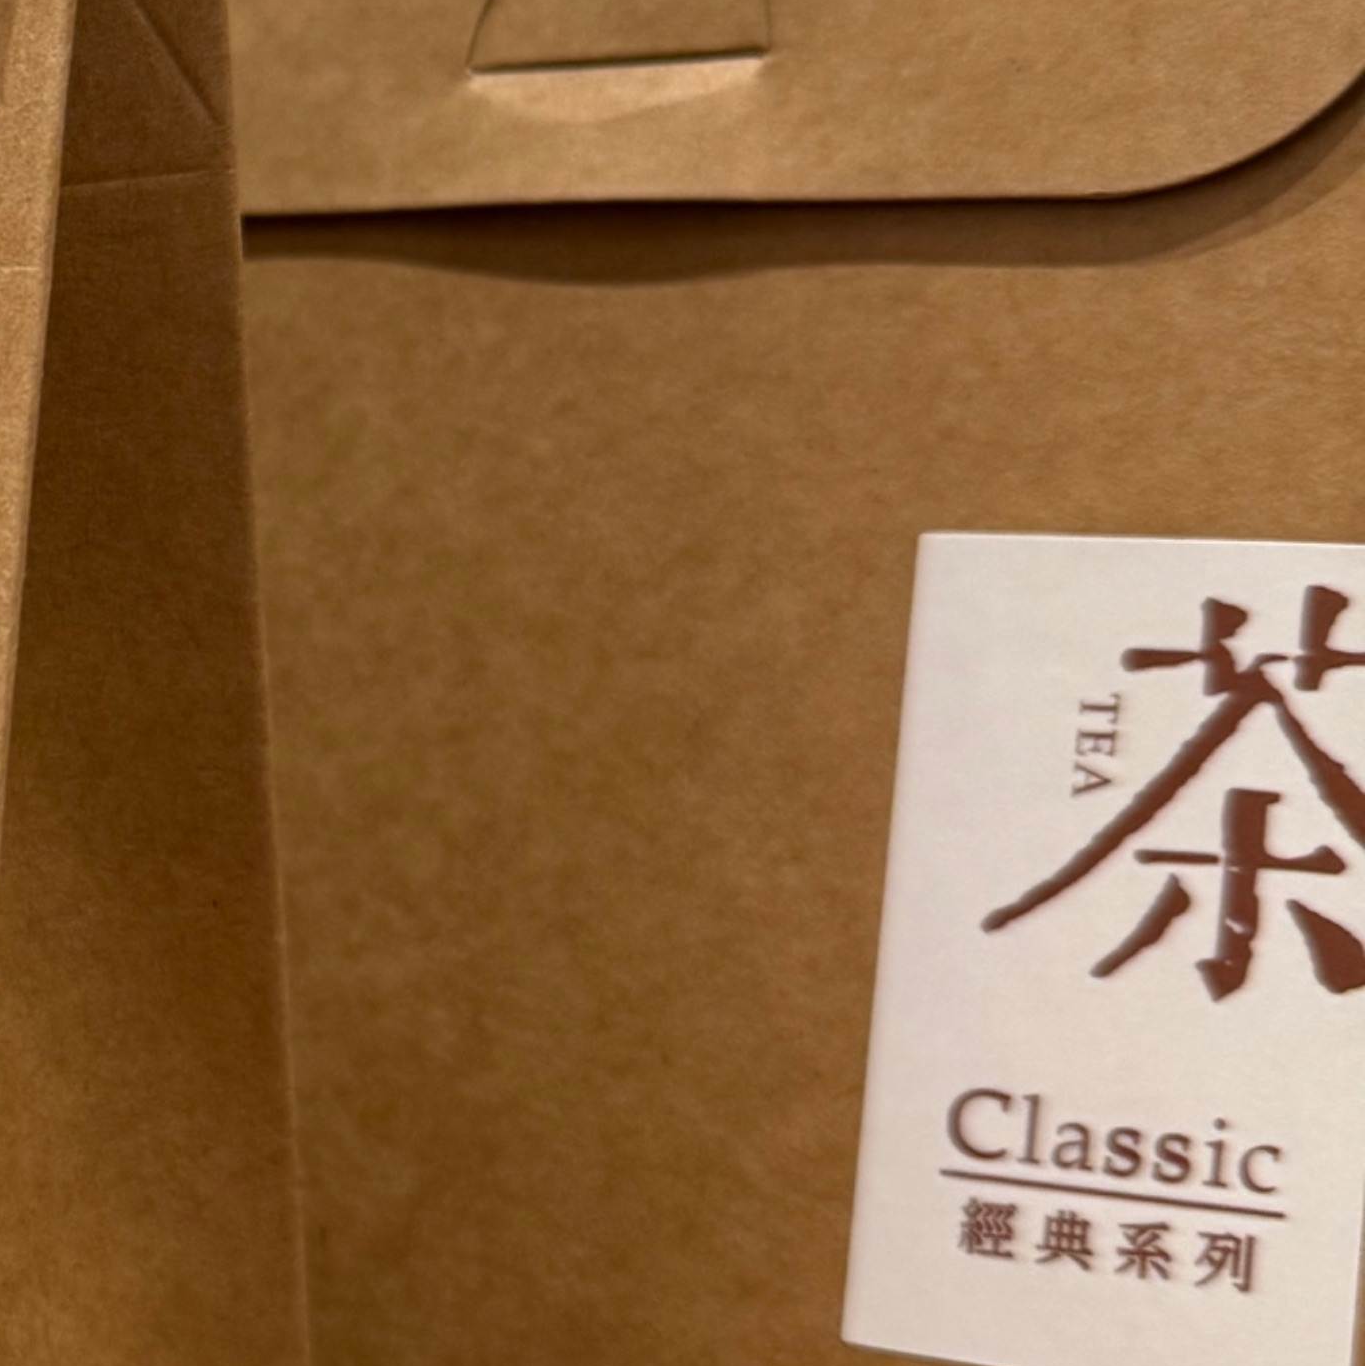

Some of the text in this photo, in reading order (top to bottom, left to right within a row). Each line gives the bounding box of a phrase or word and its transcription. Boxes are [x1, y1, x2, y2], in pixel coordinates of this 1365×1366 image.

[981, 585, 1365, 1002] 茶
[1072, 694, 1119, 798] TEA
[946, 1088, 1283, 1195] Classic
[959, 1199, 1257, 1293] 經典系列
